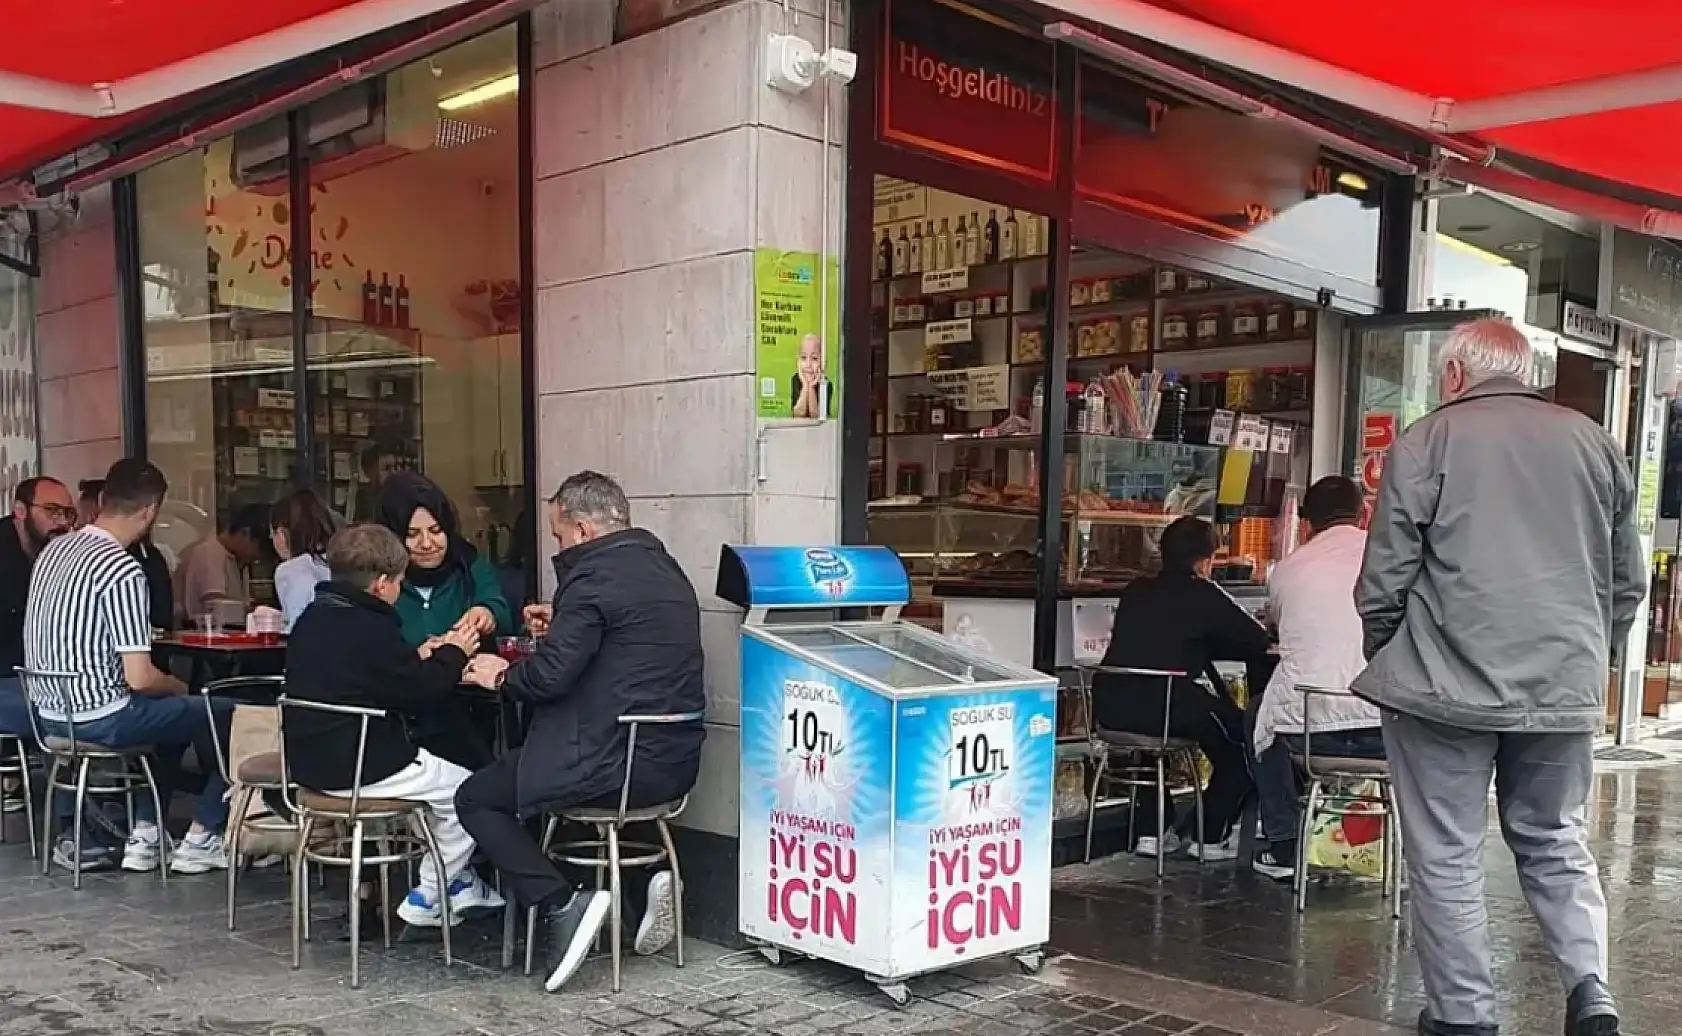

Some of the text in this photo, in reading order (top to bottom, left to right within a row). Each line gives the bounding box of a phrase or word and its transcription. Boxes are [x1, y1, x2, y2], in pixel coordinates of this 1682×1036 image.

[898, 40, 1047, 116] Hoşgeldiniz
[785, 683, 825, 702] SOĞUK
[952, 706, 1012, 727] SOĞUK SU
[770, 808, 785, 825] İYİ
[830, 820, 856, 842] İÇİN
[929, 816, 1020, 845] İYİ YAŞAM İÇİN
[769, 827, 857, 884] İYİ SU
[929, 838, 1022, 889] İYİ SU
[768, 867, 857, 945] İÇİN
[928, 881, 1021, 954] İÇİN
